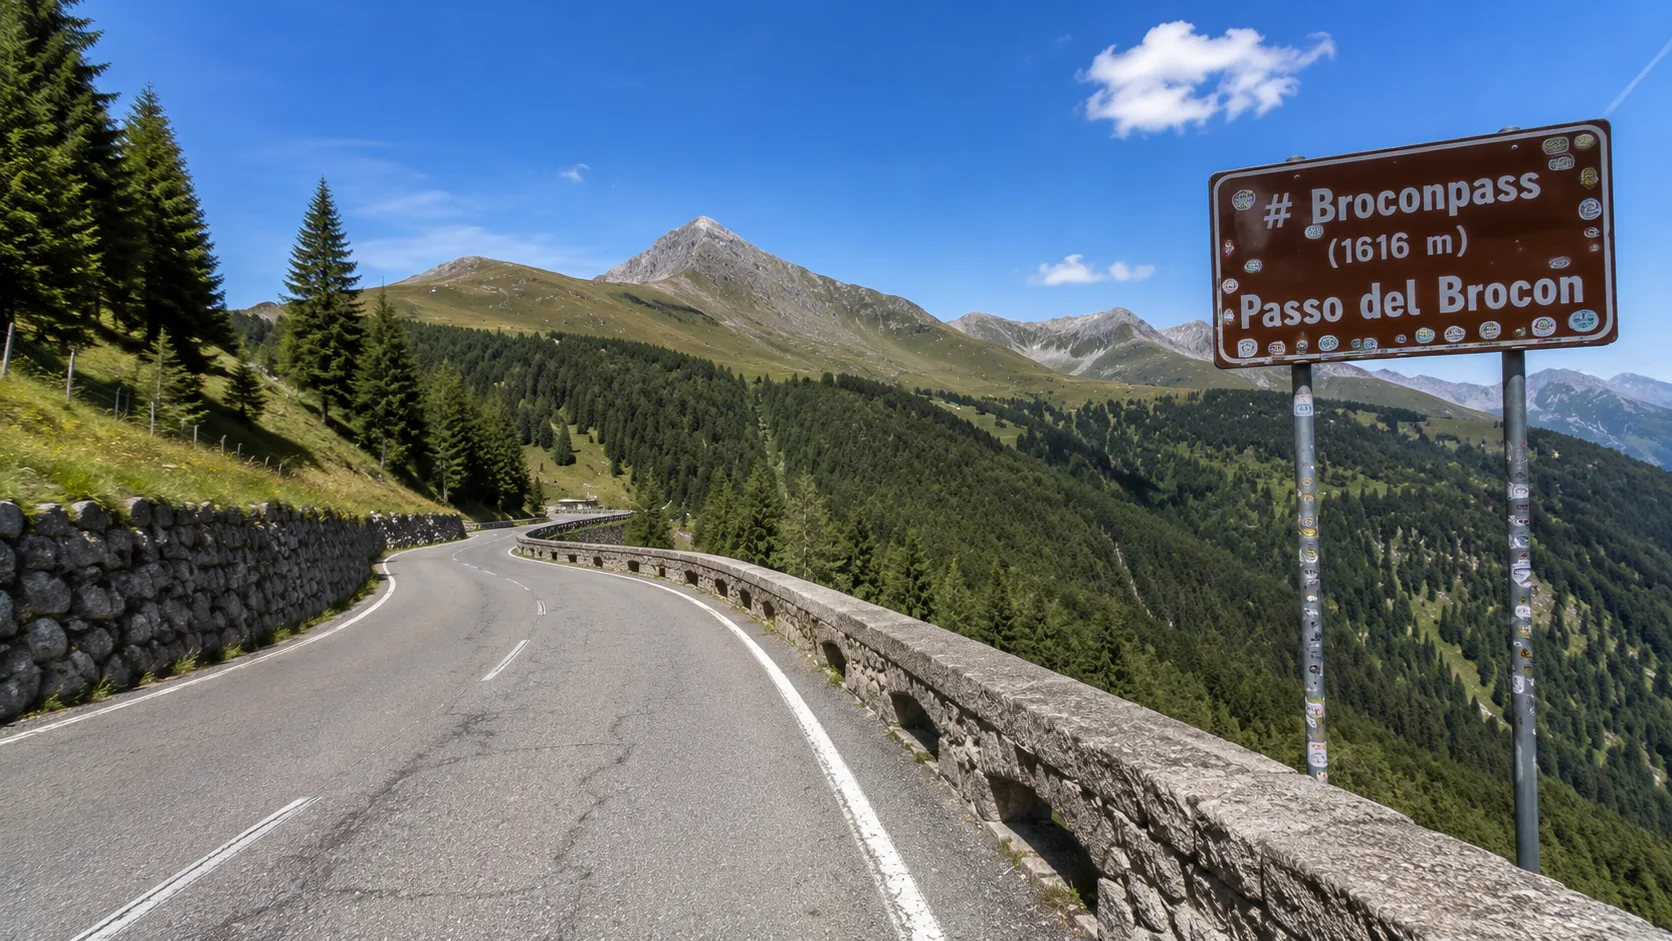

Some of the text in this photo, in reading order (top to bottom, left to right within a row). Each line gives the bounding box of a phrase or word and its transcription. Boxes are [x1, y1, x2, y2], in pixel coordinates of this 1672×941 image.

[1264, 192, 1292, 229] #
[1311, 172, 1541, 225] Broconpass
[1329, 225, 1468, 268] (1616 m)
[1240, 275, 1584, 330] Passo del Brocon
